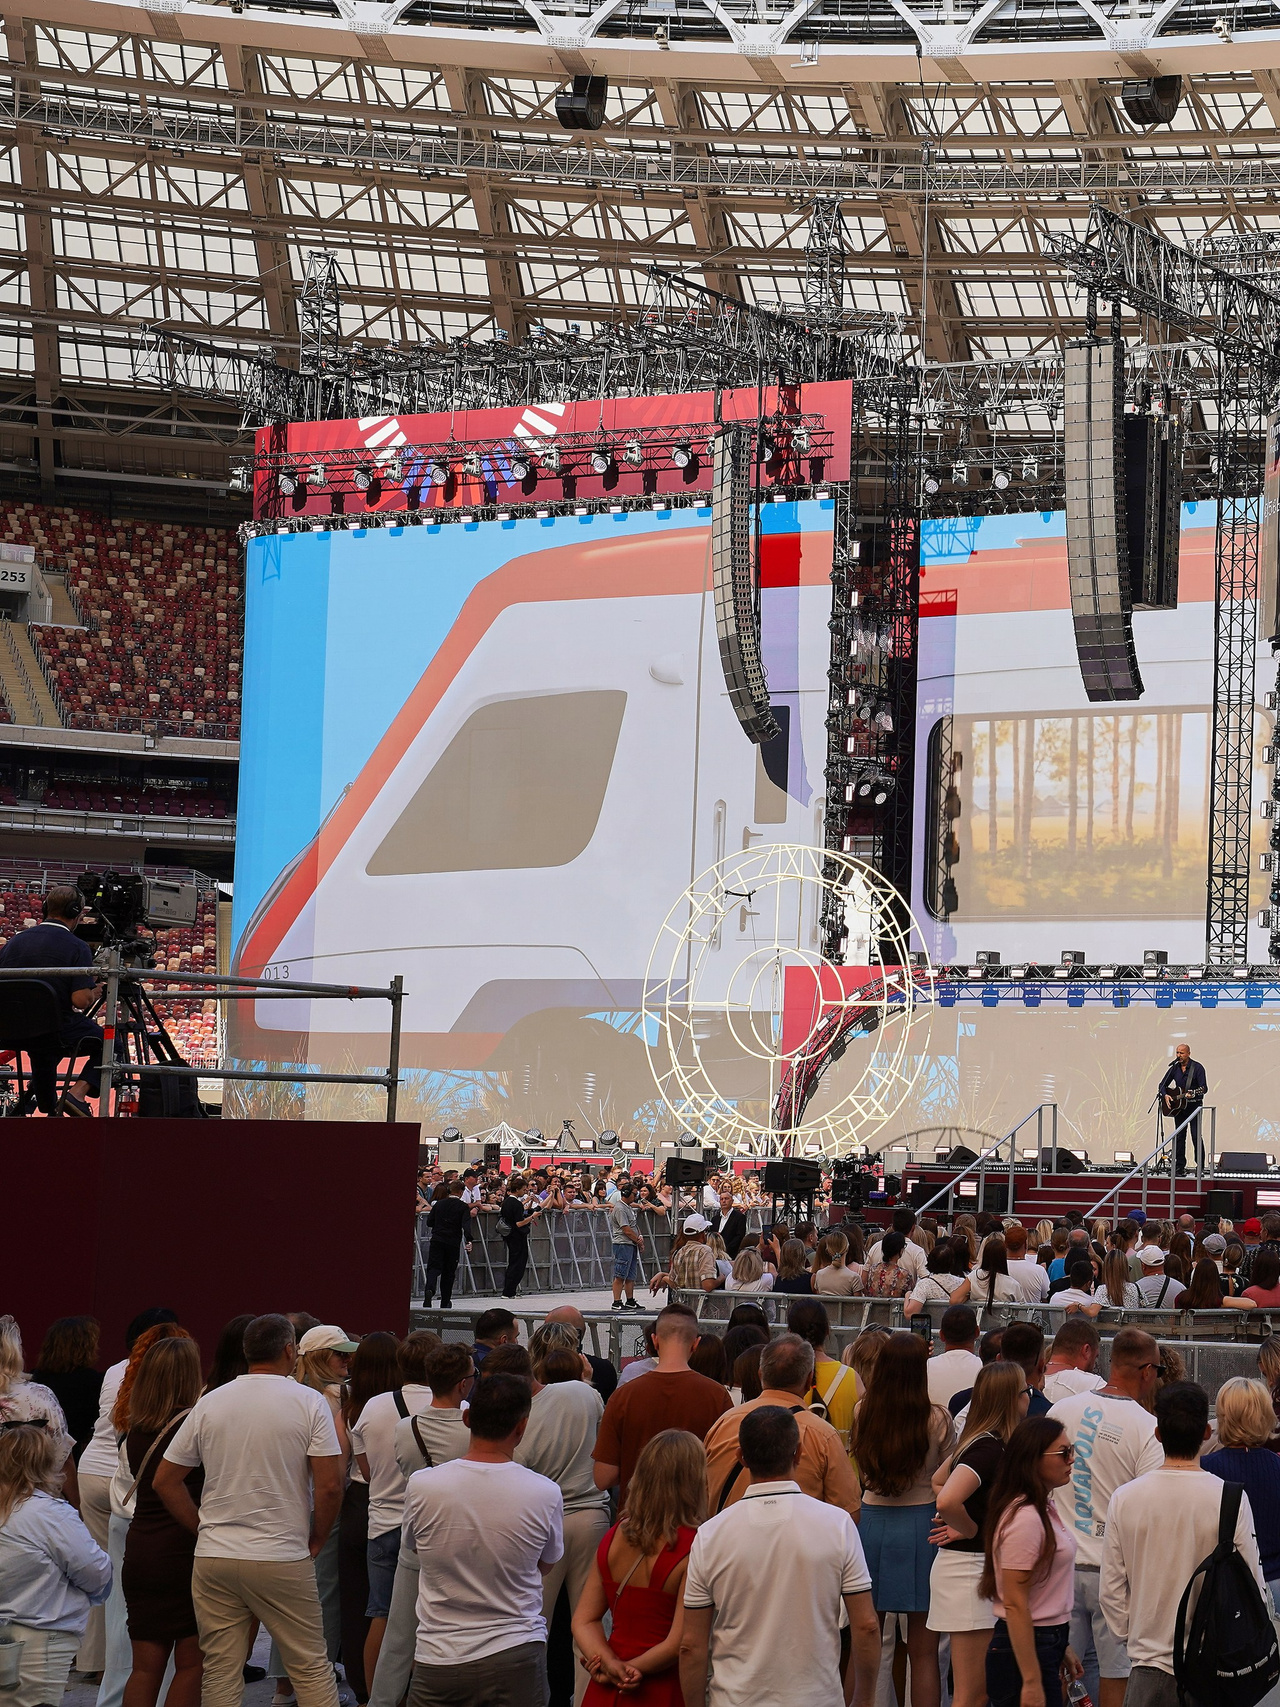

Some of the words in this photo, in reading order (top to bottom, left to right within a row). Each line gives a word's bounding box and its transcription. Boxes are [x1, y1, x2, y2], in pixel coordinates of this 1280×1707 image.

[1, 571, 26, 583] 253
[264, 965, 290, 980] 013
[1074, 1406, 1103, 1537] AQUAPOLIS
